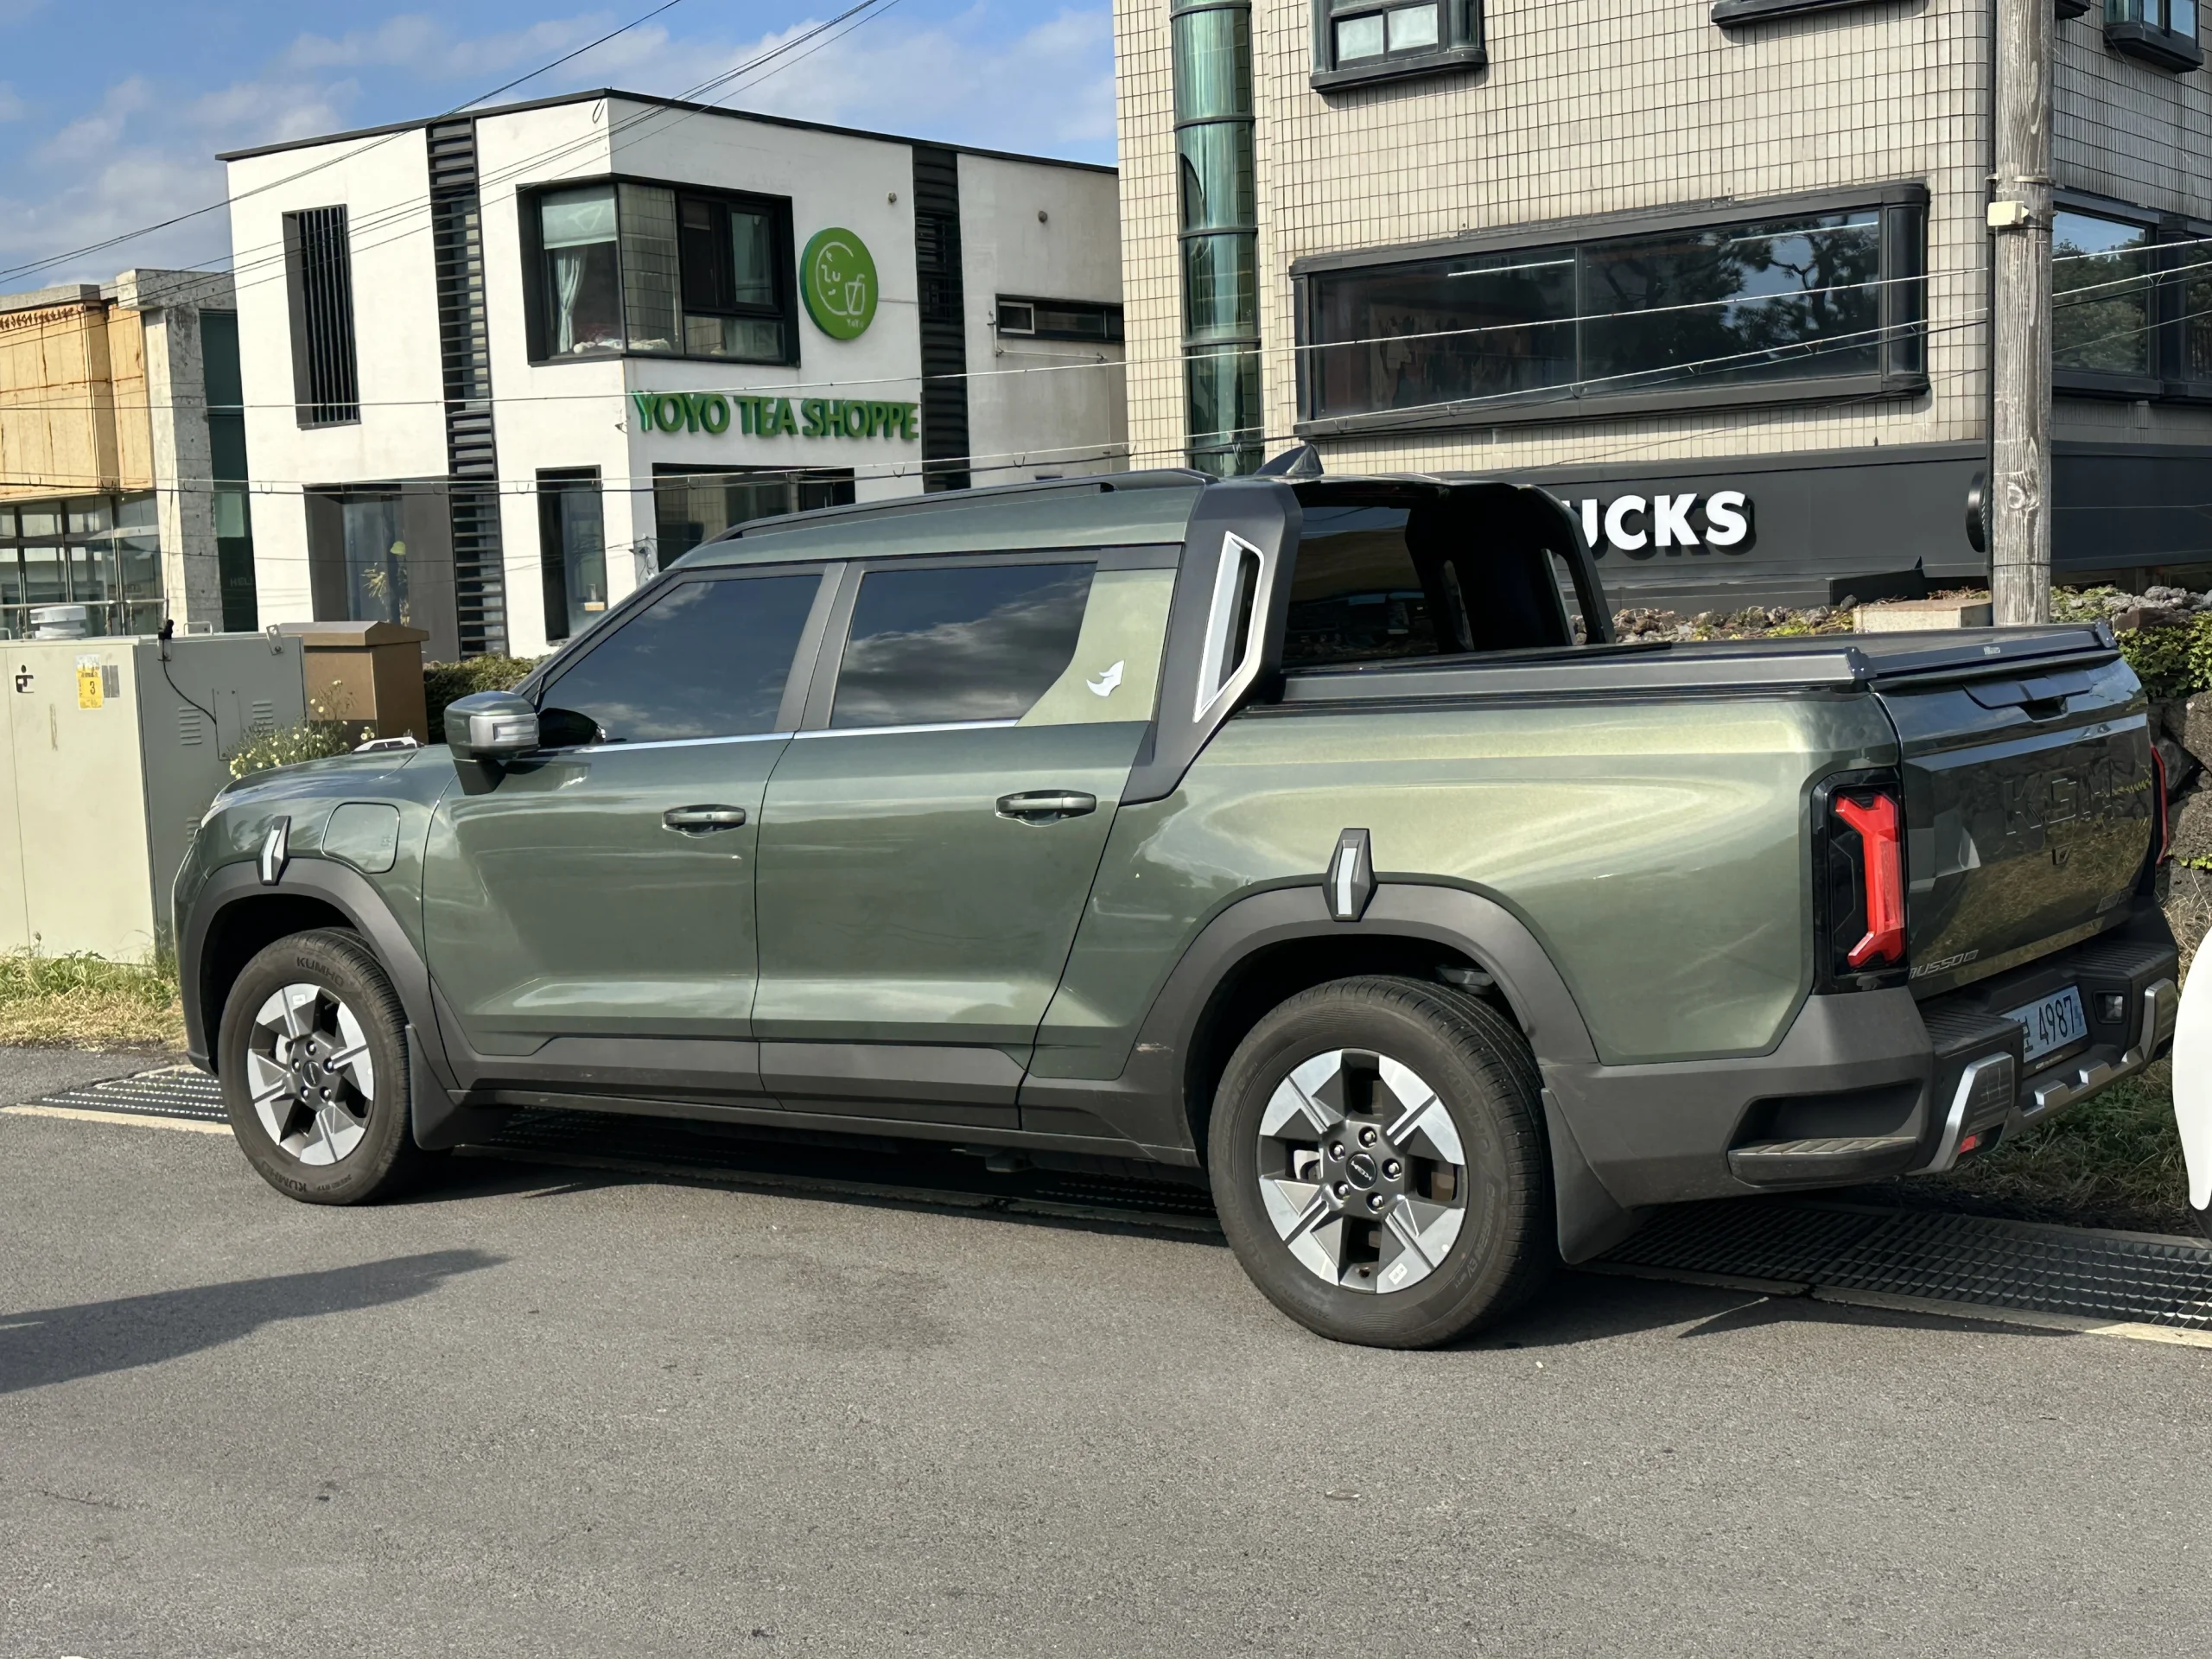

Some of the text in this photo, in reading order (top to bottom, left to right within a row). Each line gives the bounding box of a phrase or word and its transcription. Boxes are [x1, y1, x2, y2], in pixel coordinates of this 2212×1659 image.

[631, 390, 919, 440] YOYO TEA SHOPPE
[296, 957, 345, 988] KUMHO
[2038, 995, 2075, 1046] 4987
